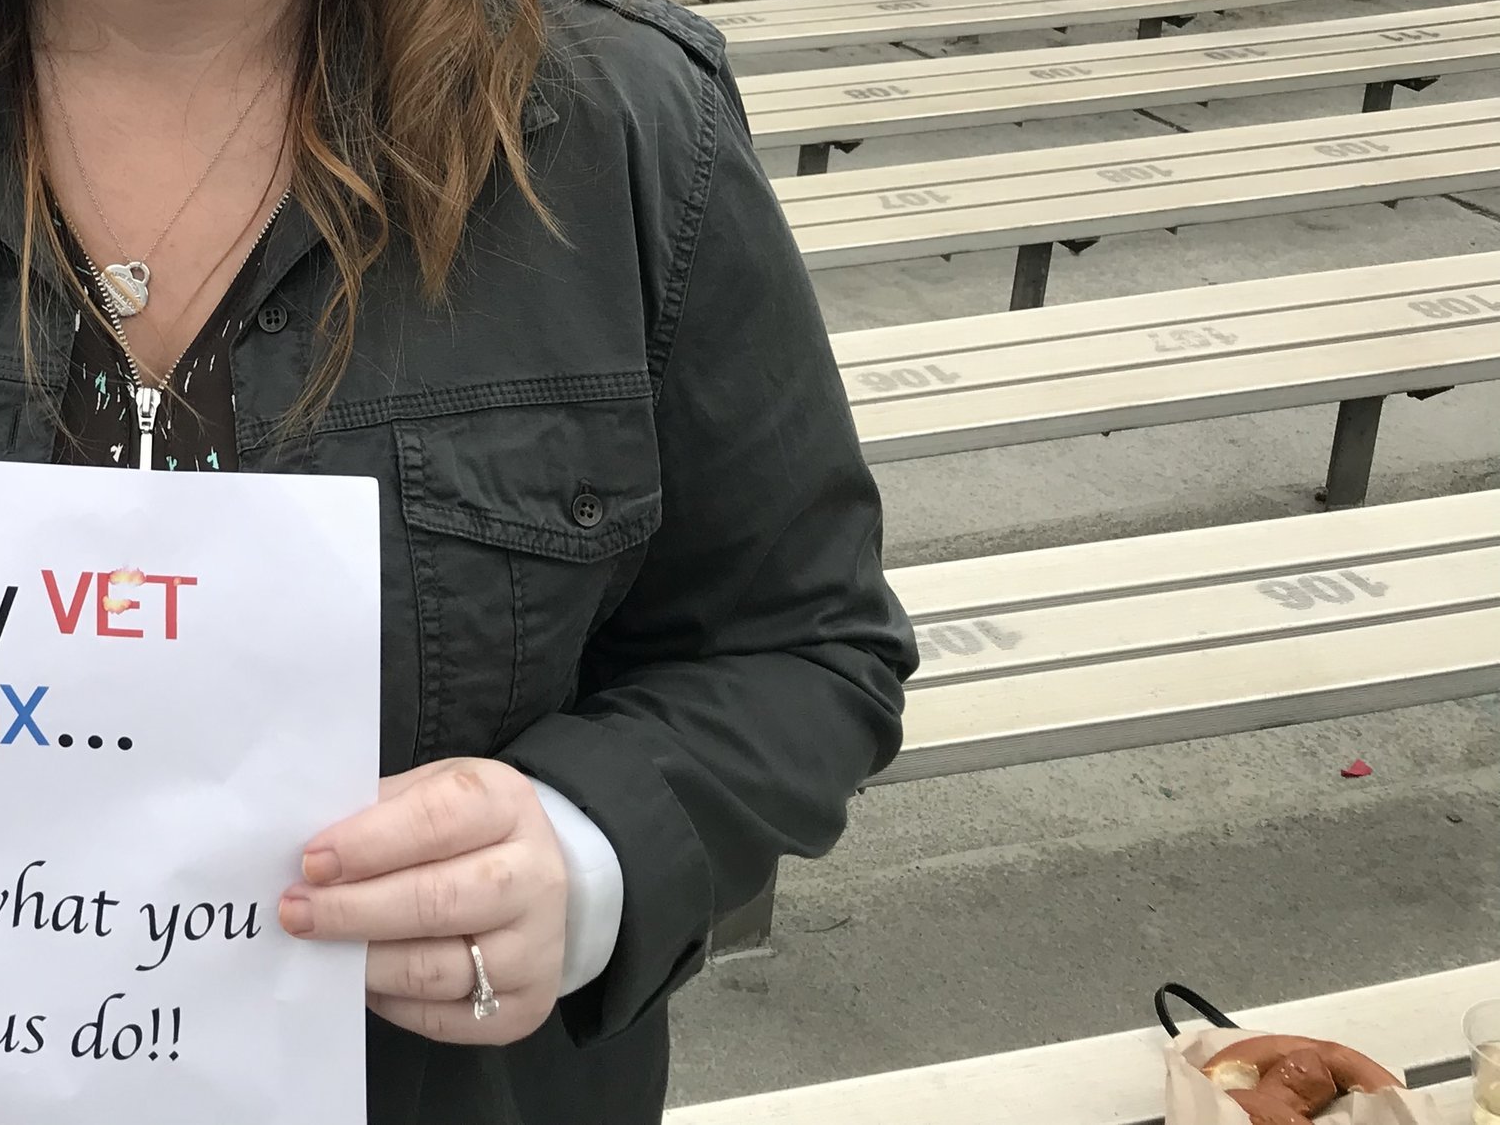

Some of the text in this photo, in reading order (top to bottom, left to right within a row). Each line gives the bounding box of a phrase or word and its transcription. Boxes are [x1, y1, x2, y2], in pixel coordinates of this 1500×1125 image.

[842, 84, 911, 101] 108
[877, 188, 953, 211] 107
[1407, 294, 1500, 319] 108
[858, 363, 963, 393] 106
[40, 568, 198, 640] VET
[1254, 569, 1392, 611] 106
[134, 894, 262, 972] you
[70, 992, 183, 1063] do!!
